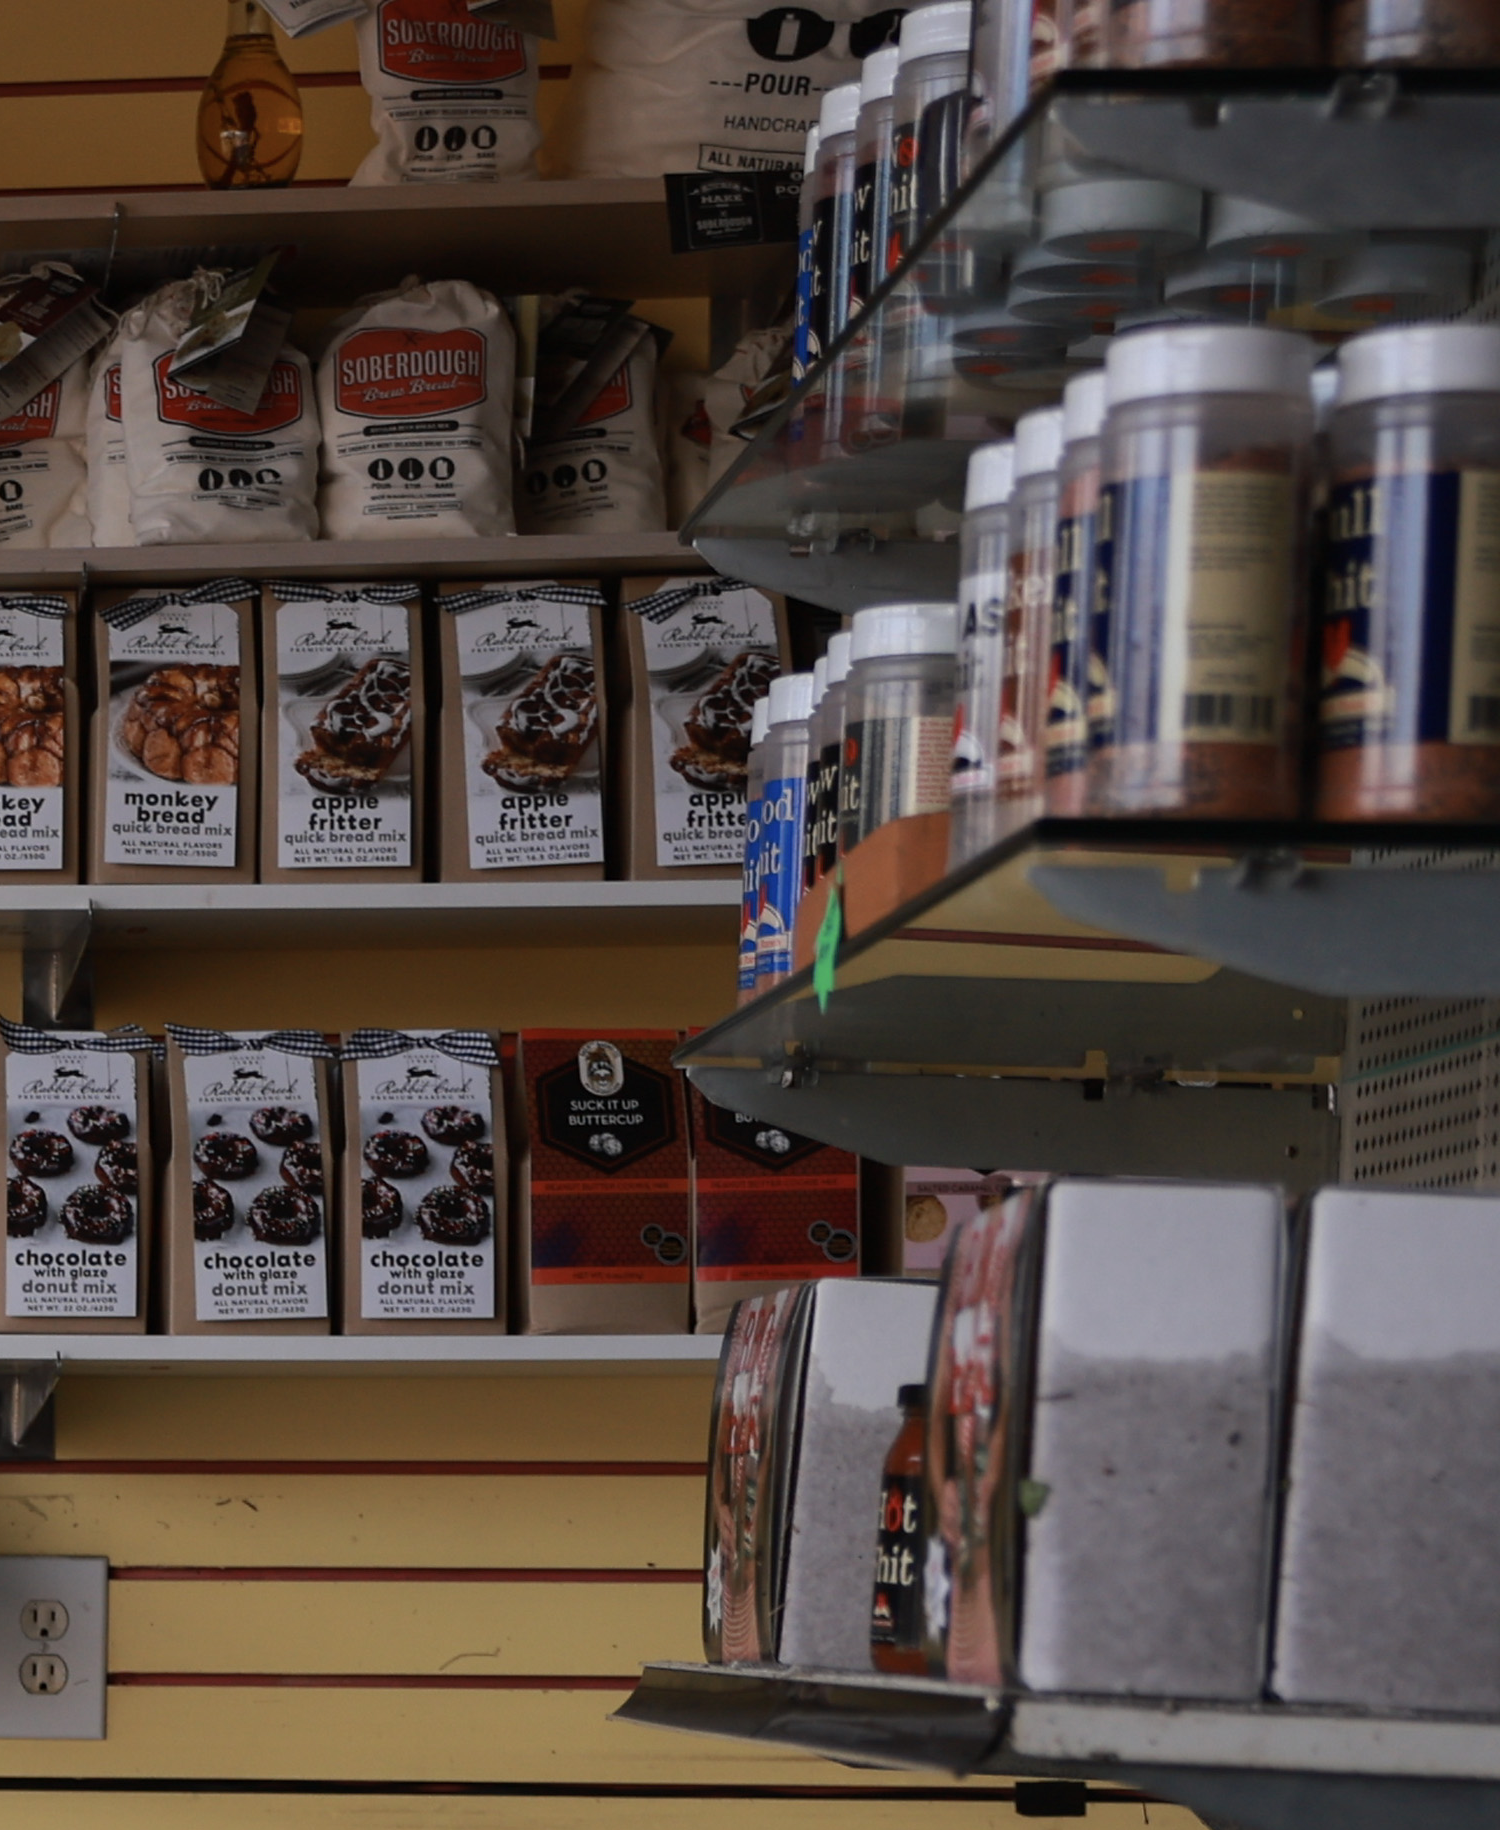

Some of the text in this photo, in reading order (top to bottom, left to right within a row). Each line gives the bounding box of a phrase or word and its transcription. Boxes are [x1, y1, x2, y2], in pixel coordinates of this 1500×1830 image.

[708, 151, 732, 168] ALL
[341, 349, 480, 386] SOBERDOUGH
[409, 375, 459, 395] Bread
[124, 791, 218, 811] monkey
[312, 795, 379, 816] apple
[501, 792, 569, 816] apple
[137, 806, 205, 823] bread
[309, 813, 383, 830] fritter
[499, 813, 573, 830] fritter
[32, 826, 60, 838] mix
[112, 822, 232, 836] quick mix
[569, 1099, 640, 1111] SUCK IT UP
[568, 1113, 644, 1127] BUTTERCUP
[15, 1249, 127, 1266] chocolate
[204, 1251, 316, 1270] chocolate
[370, 1251, 484, 1267] chocolate
[34, 1265, 108, 1280] with glaze
[223, 1267, 298, 1283] with glaze
[22, 1279, 117, 1294] donut mix
[212, 1280, 308, 1296] donut mix
[378, 1280, 474, 1296] donut mix
